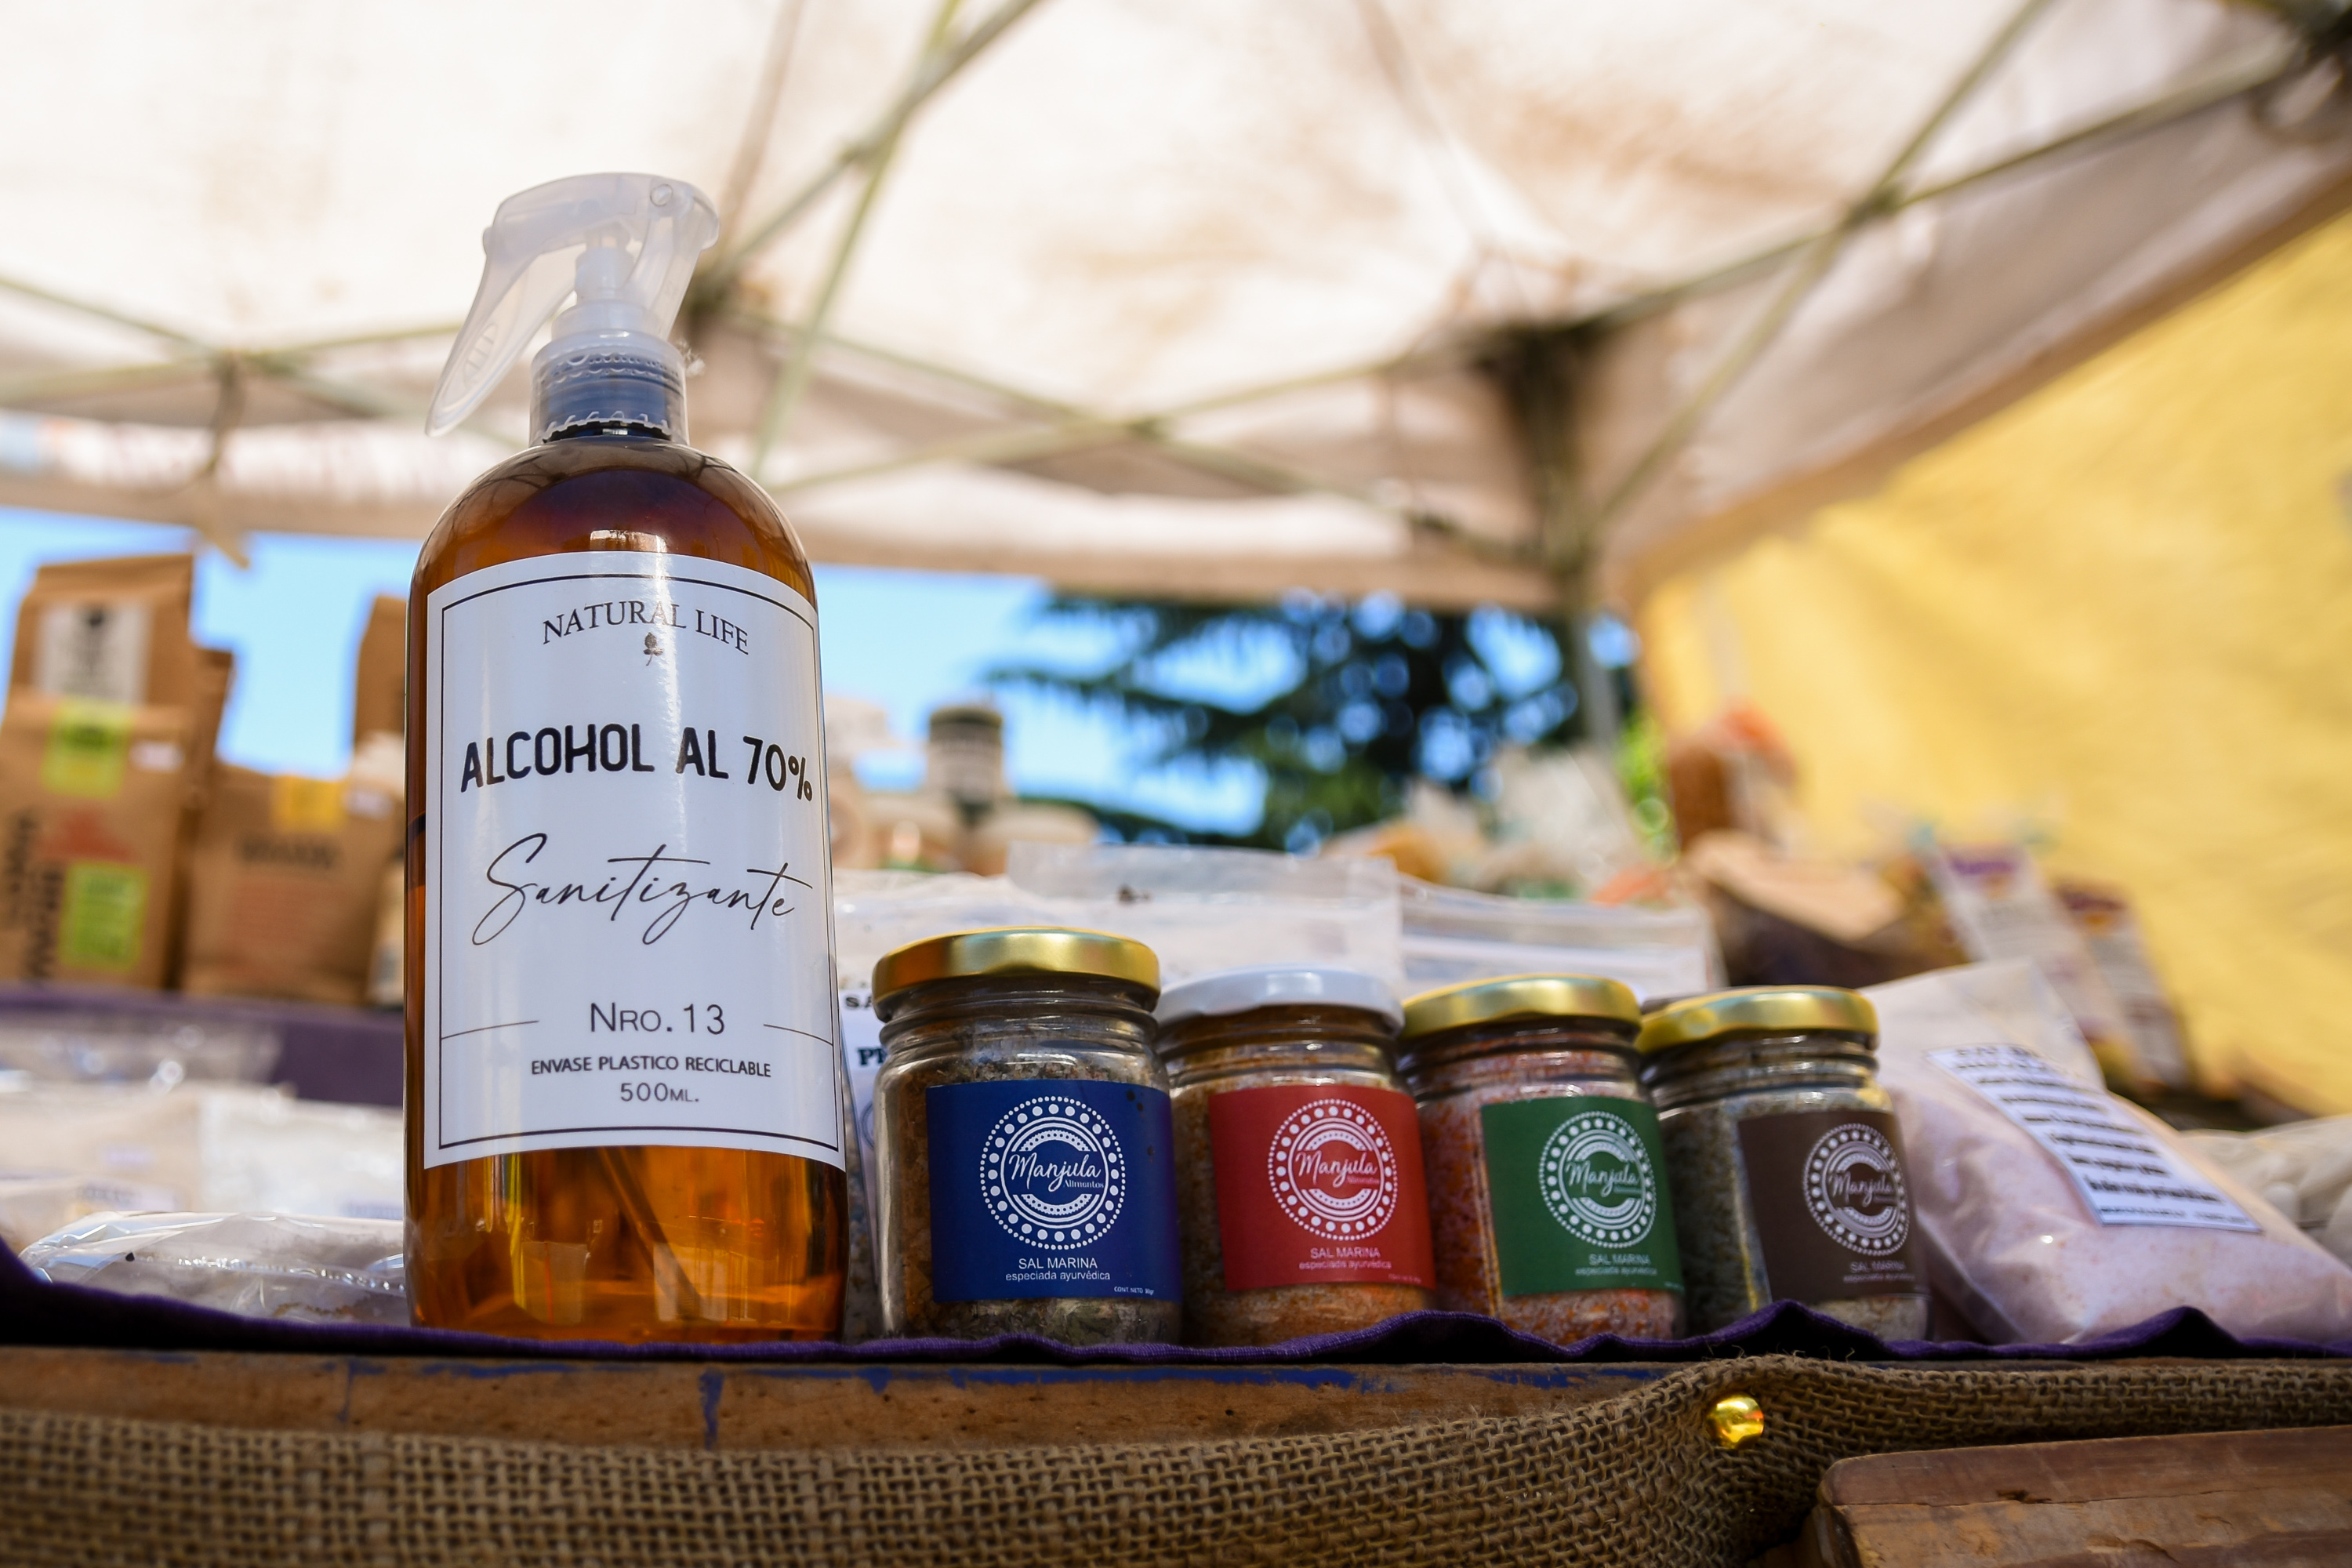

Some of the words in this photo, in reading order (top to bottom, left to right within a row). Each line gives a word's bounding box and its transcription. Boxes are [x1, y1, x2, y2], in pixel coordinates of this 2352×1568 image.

[543, 601, 687, 644] NATURAL
[695, 608, 749, 655] LIFE
[461, 723, 655, 793] ALCOHOL
[676, 726, 729, 780] AL
[743, 735, 813, 802] 70%
[472, 833, 813, 946] Sanitizante
[532, 1056, 593, 1075] ENVASE
[598, 1055, 679, 1071] PLASTICO
[685, 1058, 771, 1078] RECICLABLE
[1008, 1152, 1102, 1192] Manjula
[1295, 1150, 1378, 1188] Manjula
[1565, 1160, 1640, 1197] Manjula
[1018, 1258, 1044, 1269] SAL
[1047, 1257, 1098, 1269] MARINA
[1310, 1247, 1334, 1259] SAL
[1336, 1246, 1381, 1258] MARINA
[1006, 1270, 1057, 1282] especiada
[1060, 1269, 1111, 1282] ayurvédica
